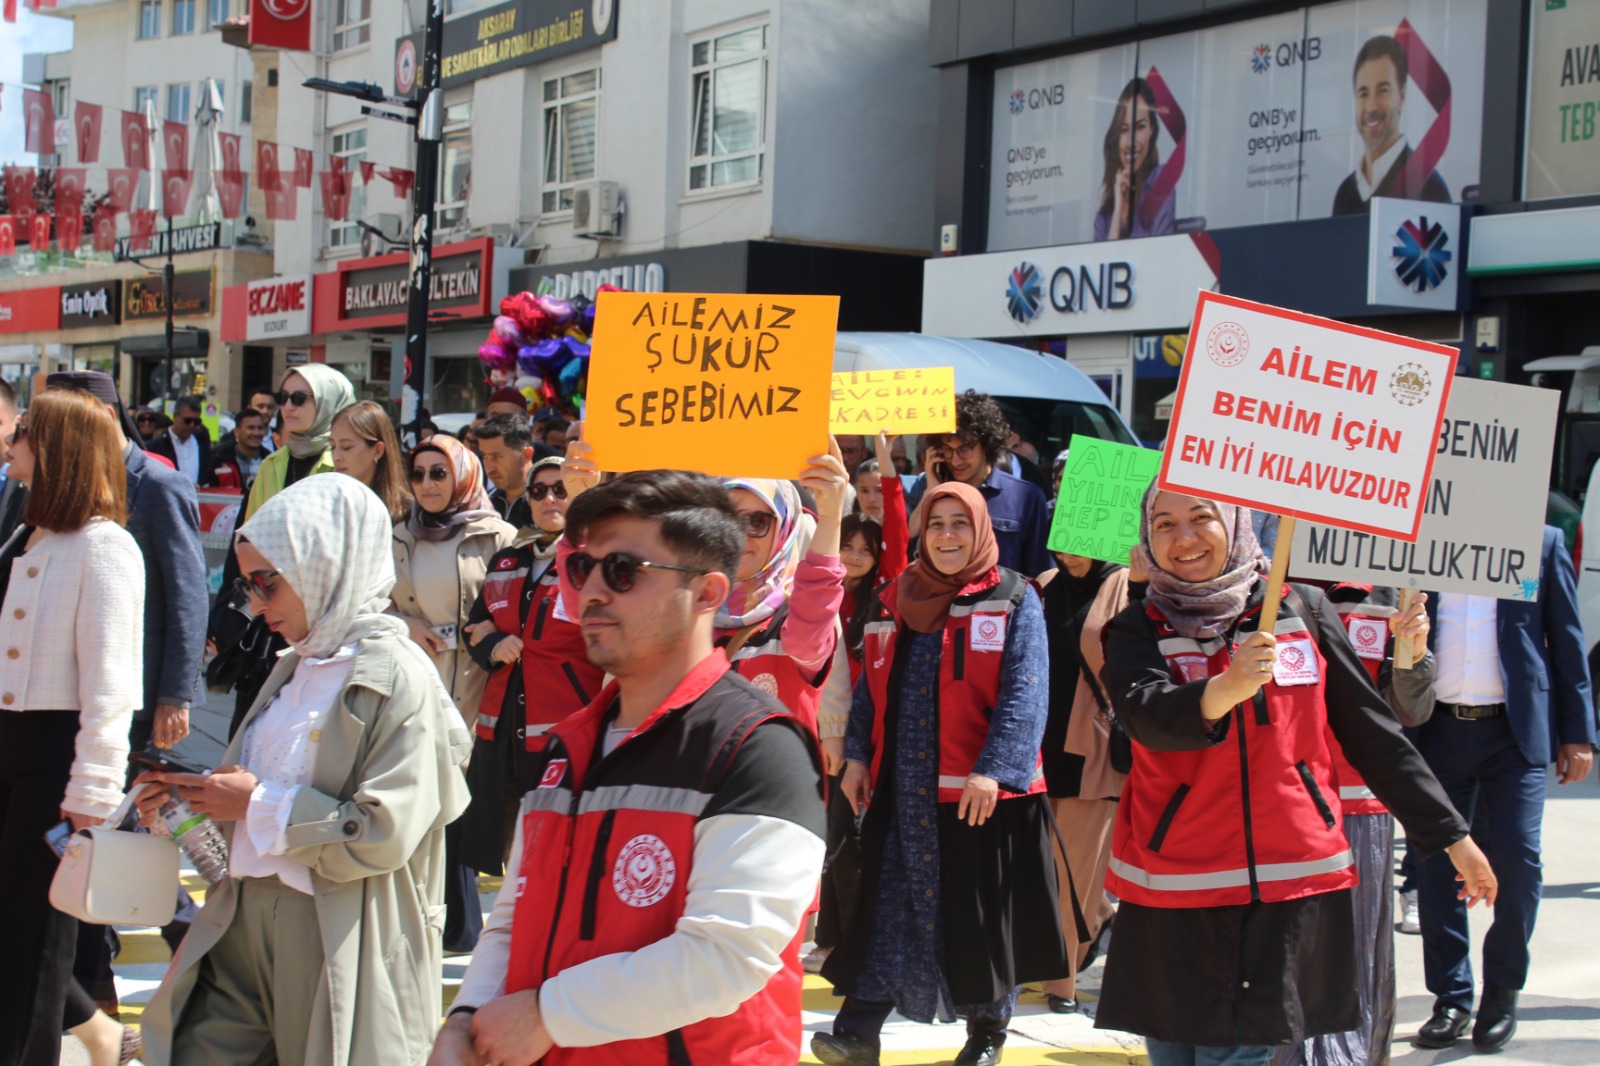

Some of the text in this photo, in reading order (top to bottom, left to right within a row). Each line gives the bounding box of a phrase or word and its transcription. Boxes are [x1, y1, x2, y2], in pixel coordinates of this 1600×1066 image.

[478, 8, 516, 40] AKSARAY
[1276, 37, 1322, 68] QNB
[1028, 84, 1065, 110] QNB
[1249, 108, 1296, 128] QNB'ye
[248, 280, 306, 316] ECZANE
[345, 281, 408, 310] BAKLAVAC
[1050, 261, 1134, 313] QNB
[631, 297, 796, 332] AİLEMİZ
[645, 332, 779, 373] ŞÜKÜR
[1259, 345, 1378, 395] AİLEM
[615, 381, 802, 427] SEBEBİMİZ
[831, 386, 948, 401] EVGİNİN
[1211, 390, 1402, 454] BENİM İÇİN
[1437, 418, 1519, 464] BENİM
[1070, 445, 1161, 482] AİL
[1180, 434, 1411, 509] EN İYİ KILAVUZDUR
[1068, 477, 1145, 510] YILIN
[1056, 505, 1140, 538] HEP B
[1307, 527, 1525, 585] MUTLULUKTUR
